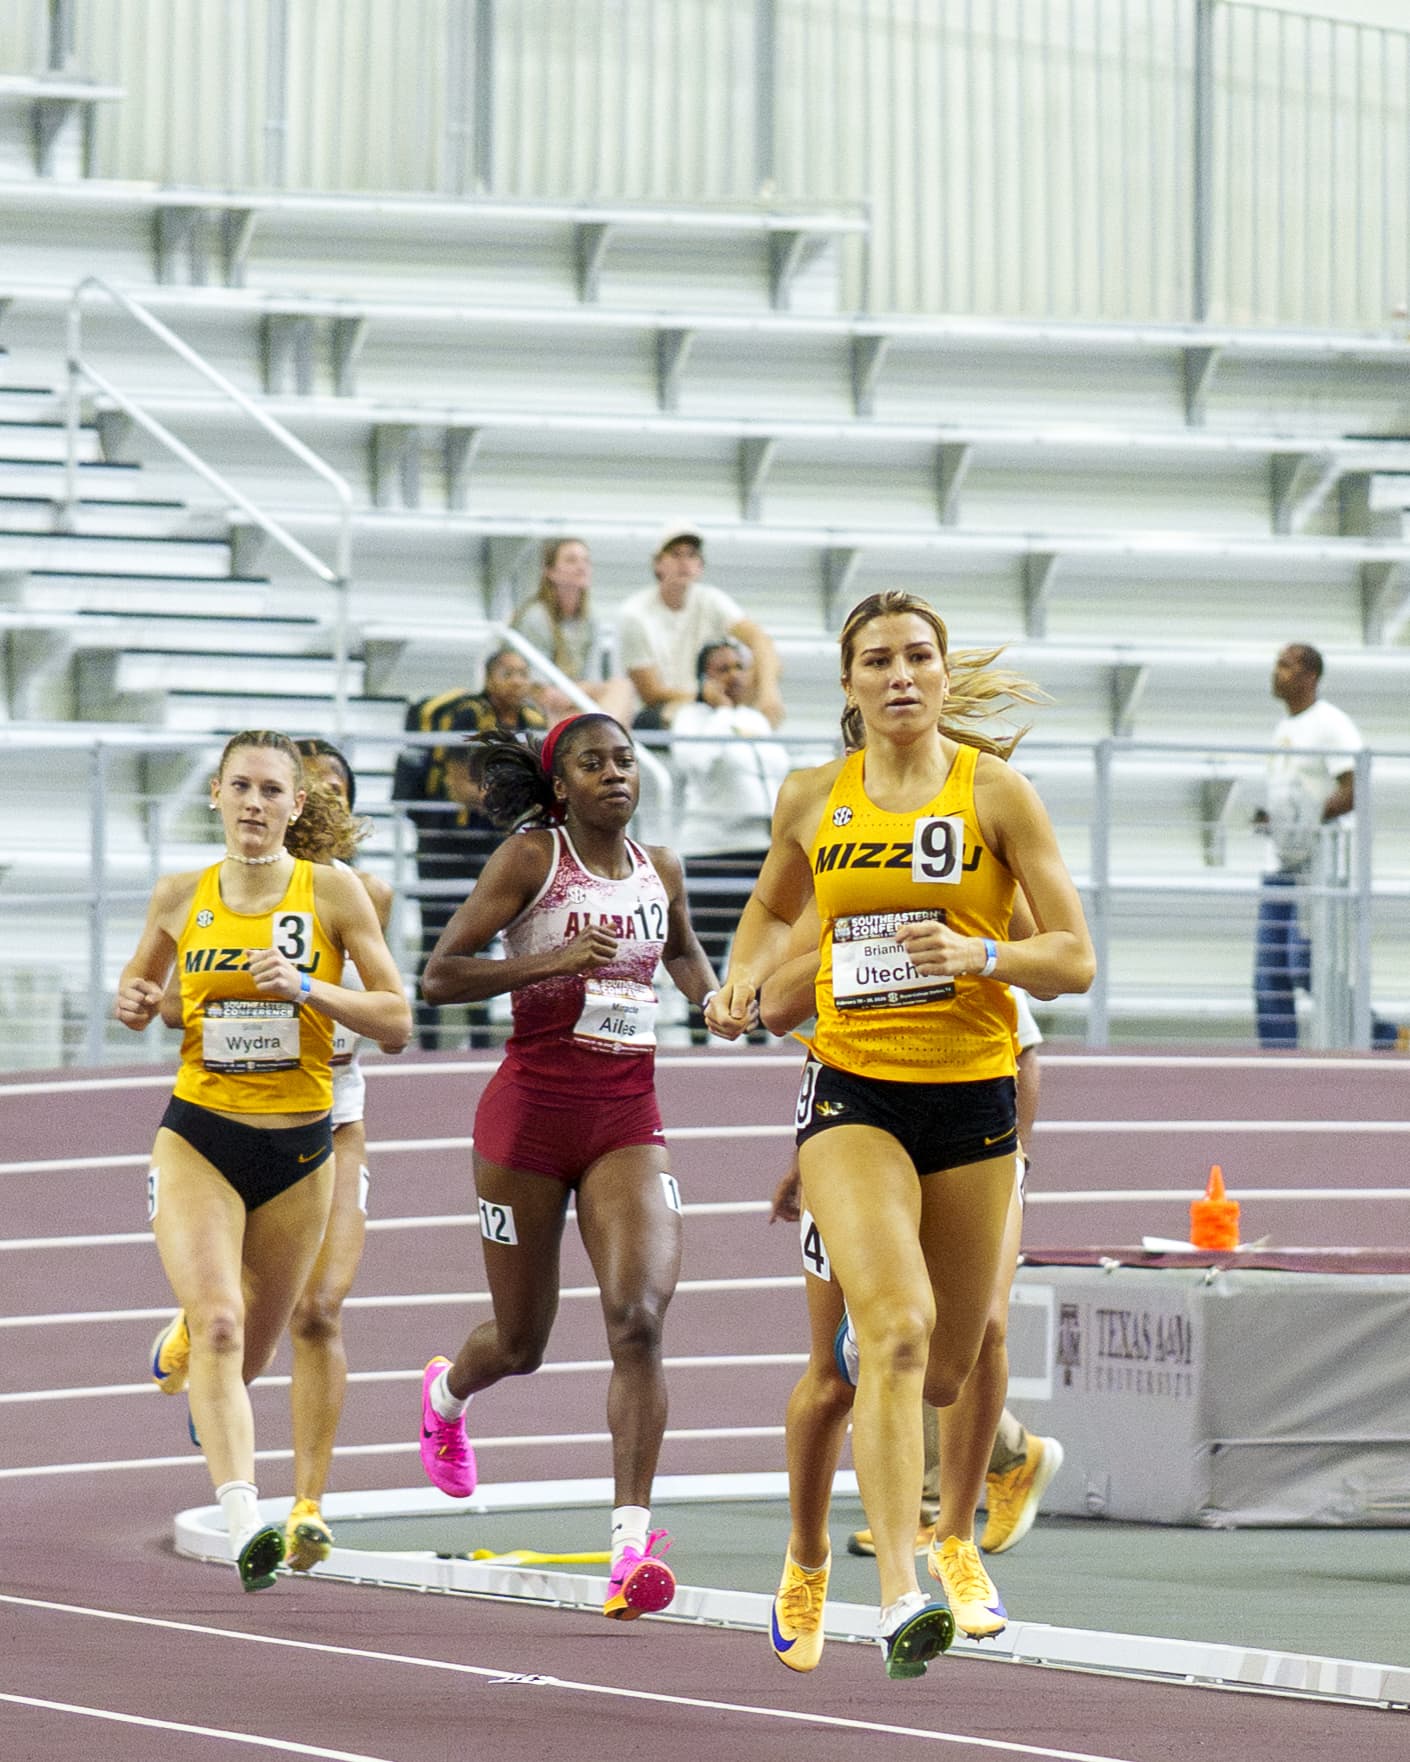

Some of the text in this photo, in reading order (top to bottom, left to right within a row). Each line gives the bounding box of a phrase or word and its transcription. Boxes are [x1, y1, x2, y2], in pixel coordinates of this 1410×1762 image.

[815, 842, 983, 876] MIZZU
[921, 821, 957, 878] 9
[278, 915, 305, 960] 3
[634, 903, 665, 940] 12
[185, 948, 320, 974] MIZU
[864, 944, 905, 957] Briann
[856, 961, 929, 985] Utech
[599, 1016, 637, 1037] Ailes
[225, 1036, 281, 1053] Wydra
[479, 1202, 511, 1243] 12
[804, 1221, 825, 1274] 4
